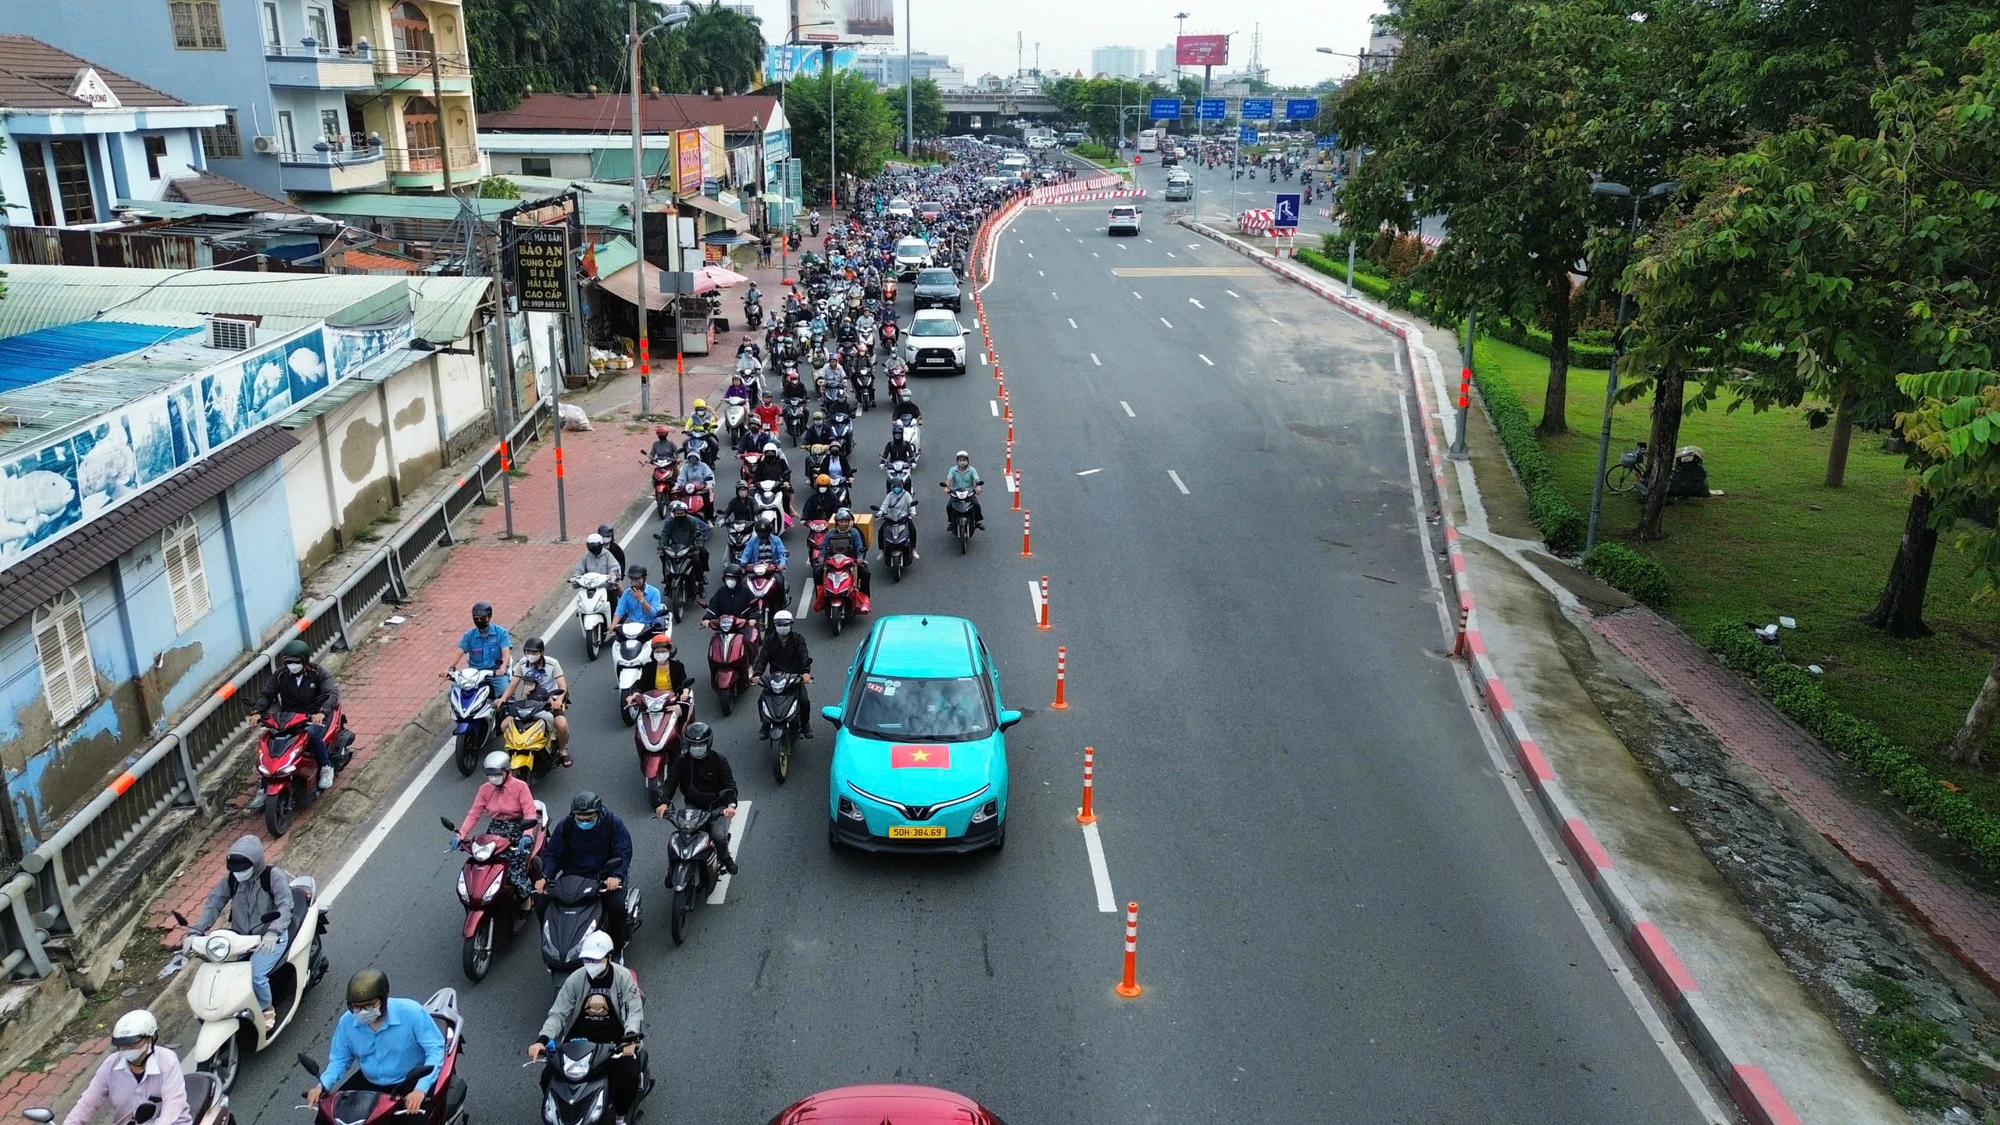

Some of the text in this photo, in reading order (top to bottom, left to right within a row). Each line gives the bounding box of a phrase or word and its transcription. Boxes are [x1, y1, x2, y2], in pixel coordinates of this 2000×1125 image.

[534, 231, 547, 242] HẢI
[548, 231, 563, 242] SẢN
[518, 242, 563, 256] BẢO AN
[520, 257, 563, 268] CUNG CẤP
[527, 278, 559, 288] HẢI SẢN
[525, 289, 562, 299] CAO CẤP
[867, 682, 883, 693] TAXI
[893, 828, 942, 837] 50H-384.69
